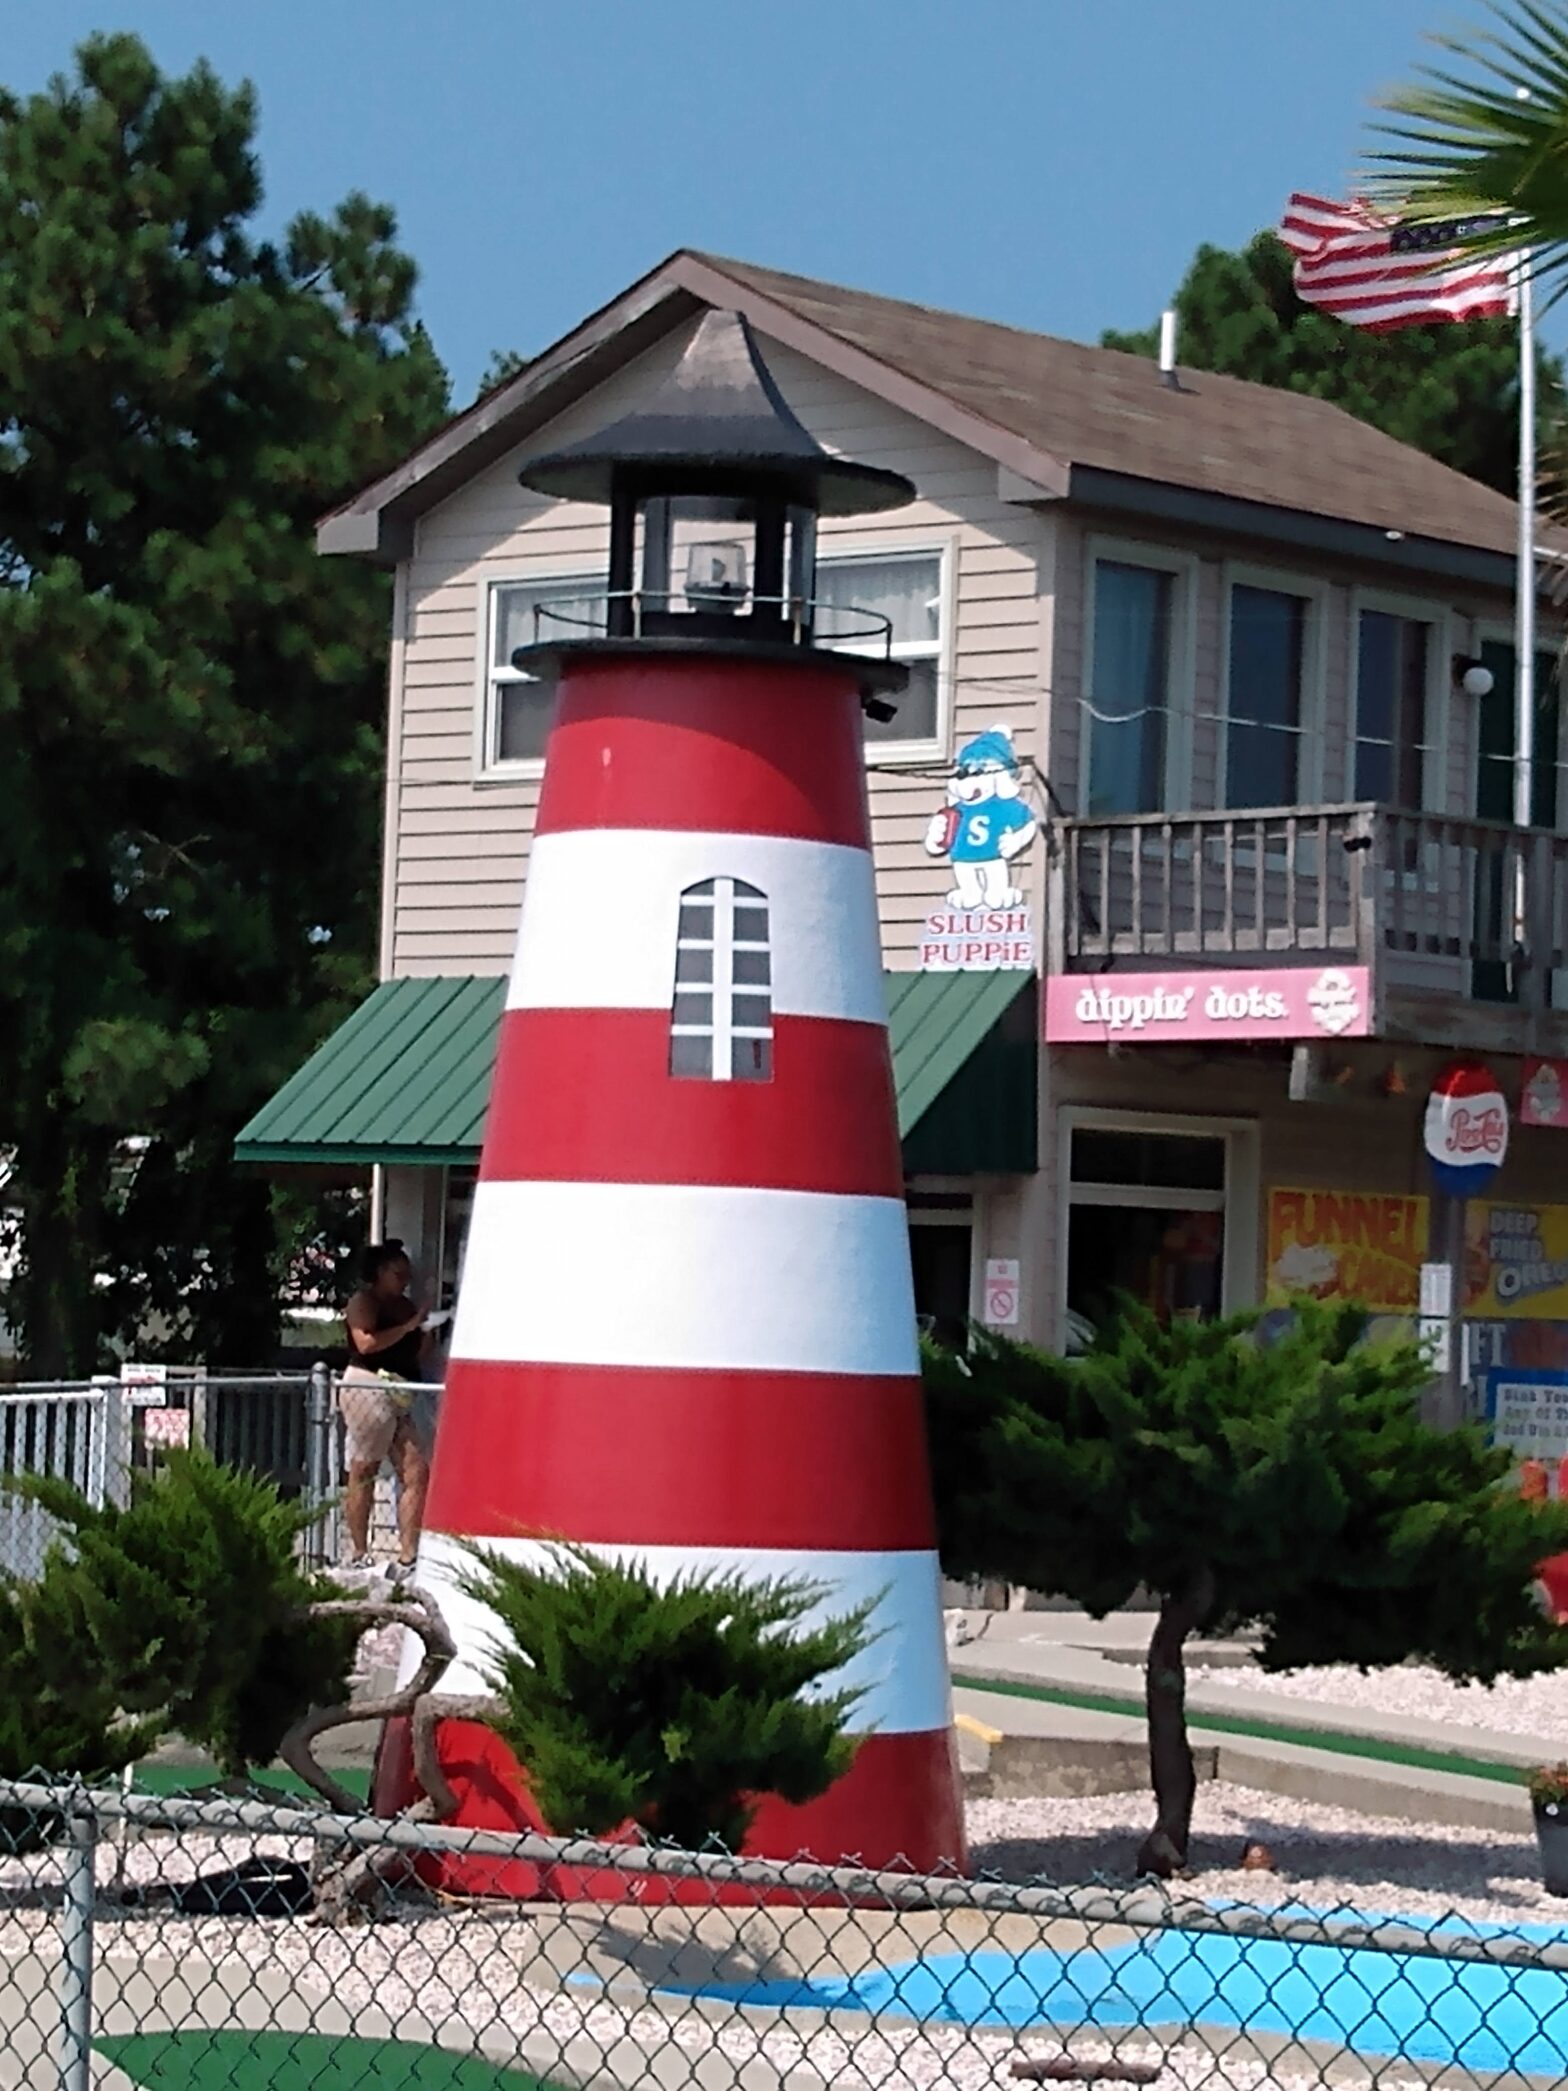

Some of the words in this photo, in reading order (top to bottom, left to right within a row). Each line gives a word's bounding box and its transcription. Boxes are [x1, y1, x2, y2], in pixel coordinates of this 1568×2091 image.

[967, 815, 990, 846] S
[928, 912, 1026, 935] SLUSH
[1273, 1191, 1425, 1267] FUNNEL
[1491, 1211, 1537, 1233] DEEP
